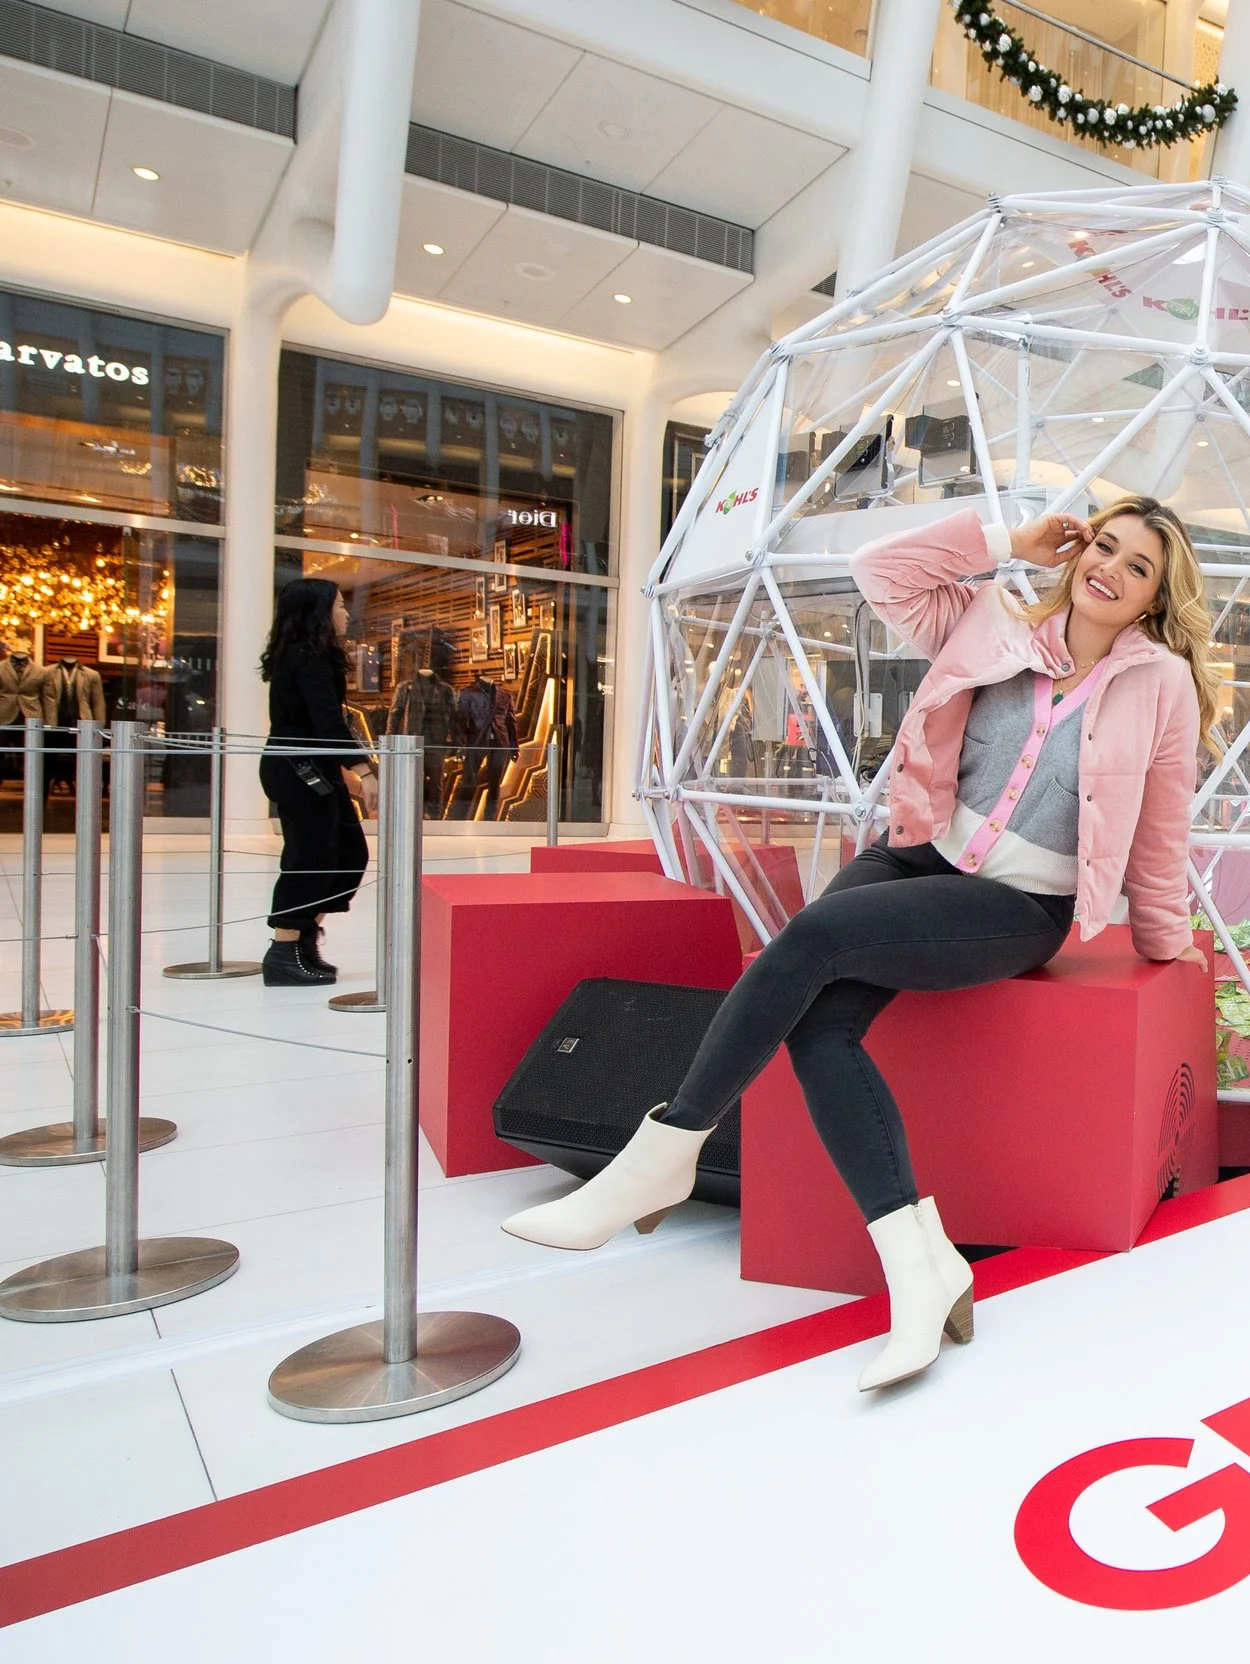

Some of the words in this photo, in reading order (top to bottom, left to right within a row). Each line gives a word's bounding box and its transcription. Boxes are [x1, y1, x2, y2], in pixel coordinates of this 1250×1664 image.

[1068, 239, 1135, 299] KHL'S
[0, 341, 149, 386] arvatos
[715, 488, 759, 513] KHL'S
